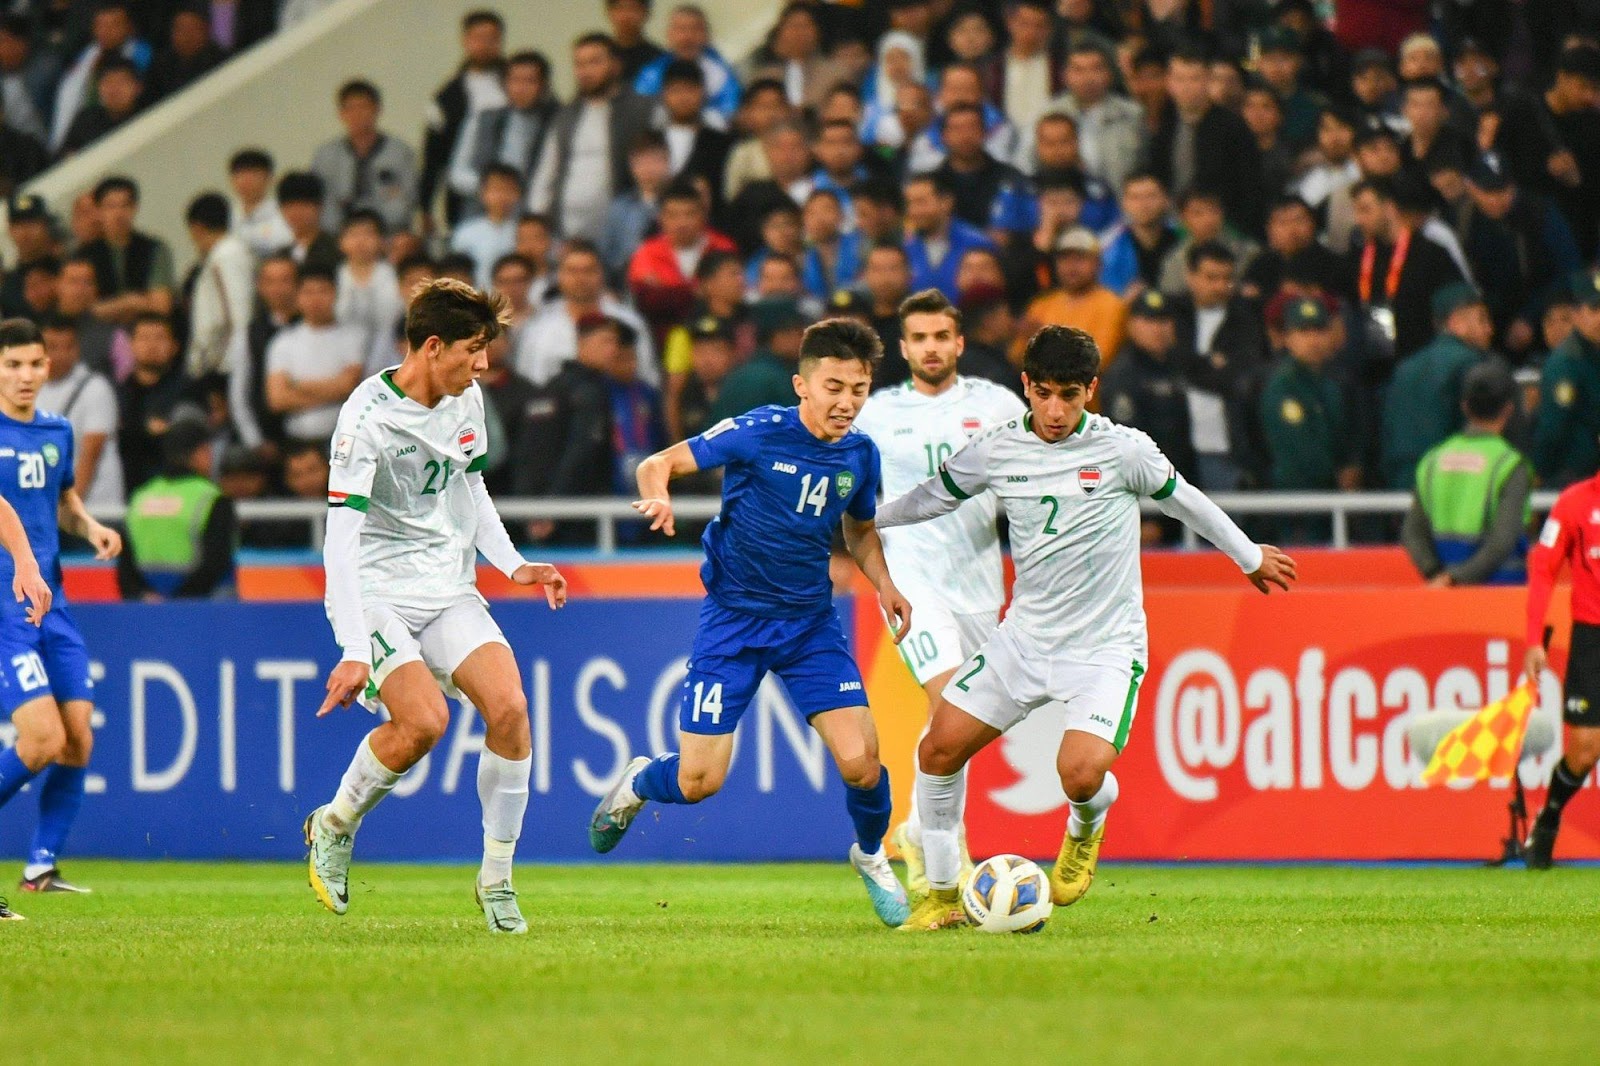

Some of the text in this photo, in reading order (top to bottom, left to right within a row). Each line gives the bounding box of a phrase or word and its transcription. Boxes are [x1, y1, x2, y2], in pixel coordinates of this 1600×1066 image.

[395, 444, 418, 458] JAKO
[771, 461, 797, 475] JAKO
[923, 442, 953, 478] 10
[17, 452, 46, 489] 20
[420, 459, 450, 496] 21
[837, 475, 853, 488] UFA
[1007, 475, 1028, 483] JAKO
[795, 473, 830, 517] 14
[1040, 495, 1060, 535] 2
[908, 630, 939, 669] 10
[10, 650, 49, 692] 20
[838, 681, 861, 692] JAKO
[955, 654, 986, 693] 2
[691, 681, 723, 724] 14
[1089, 713, 1113, 727] JAKO
